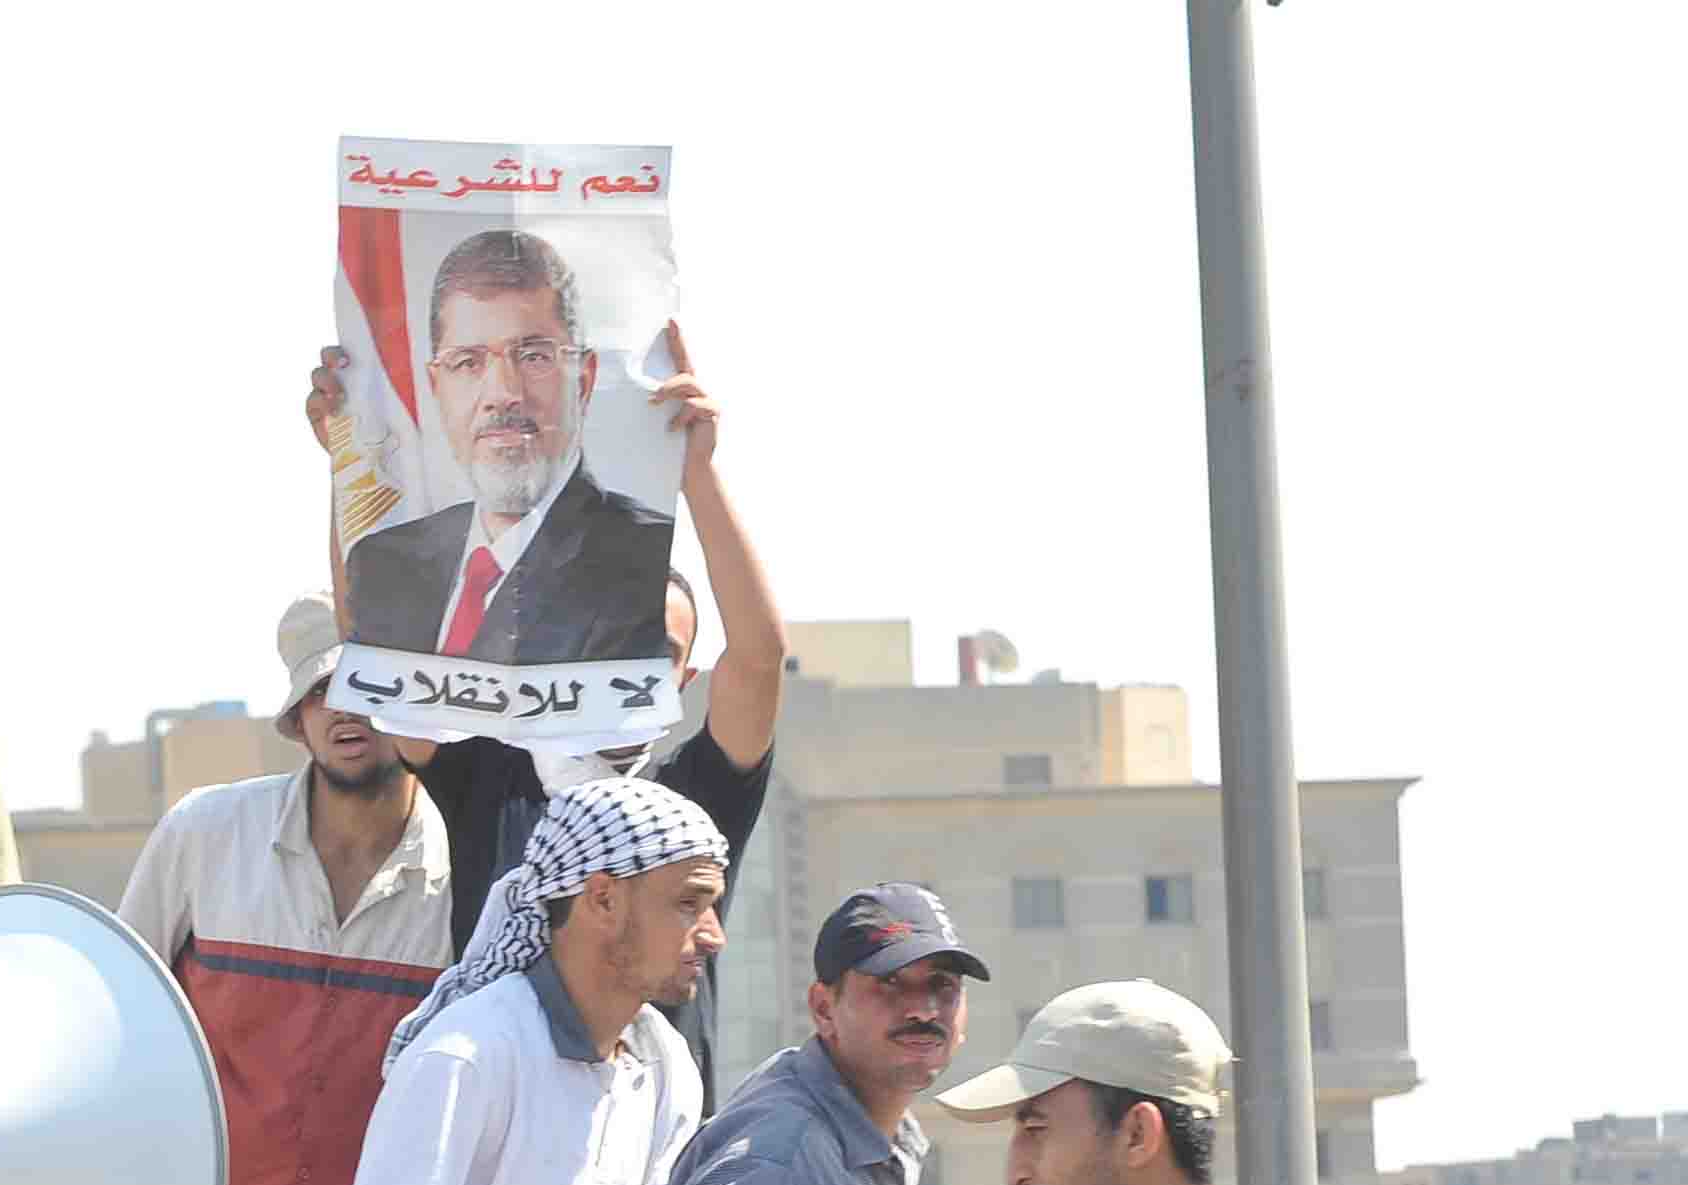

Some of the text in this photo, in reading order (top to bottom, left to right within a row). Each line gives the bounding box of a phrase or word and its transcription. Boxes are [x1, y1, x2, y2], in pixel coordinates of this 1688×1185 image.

[343, 152, 660, 200] نعم للشرعية
[347, 670, 661, 719] لا للانقلاب
